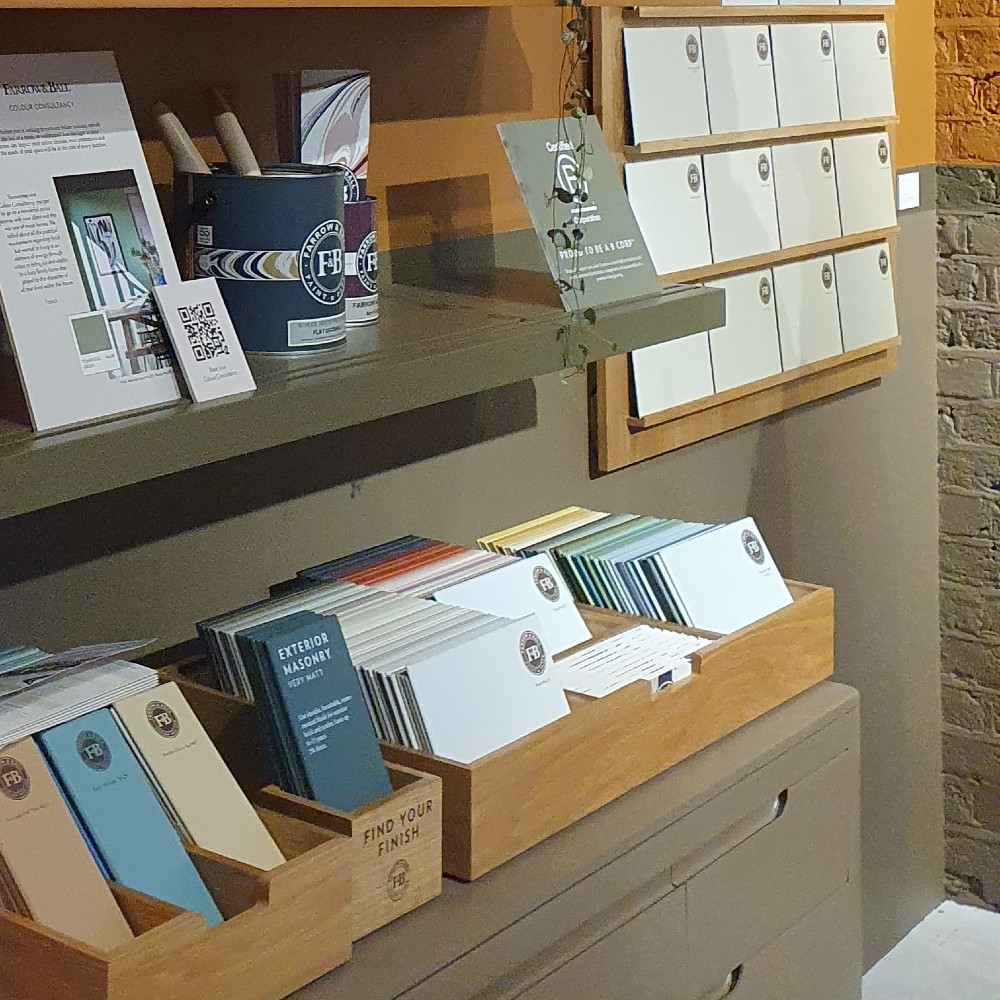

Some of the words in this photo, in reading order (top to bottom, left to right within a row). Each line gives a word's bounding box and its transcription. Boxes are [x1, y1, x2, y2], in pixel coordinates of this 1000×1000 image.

[9, 103, 33, 112] COLOUR
[34, 101, 75, 111] CONSULTANCY
[303, 222, 334, 258] FARROW
[584, 246, 594, 255] TO
[278, 632, 329, 660] EXTERIOR
[283, 648, 331, 676] MASONRY
[288, 675, 305, 688] VERY
[364, 819, 394, 844] FIND
[400, 800, 432, 826] YOUR
[378, 824, 419, 856] FINISH
